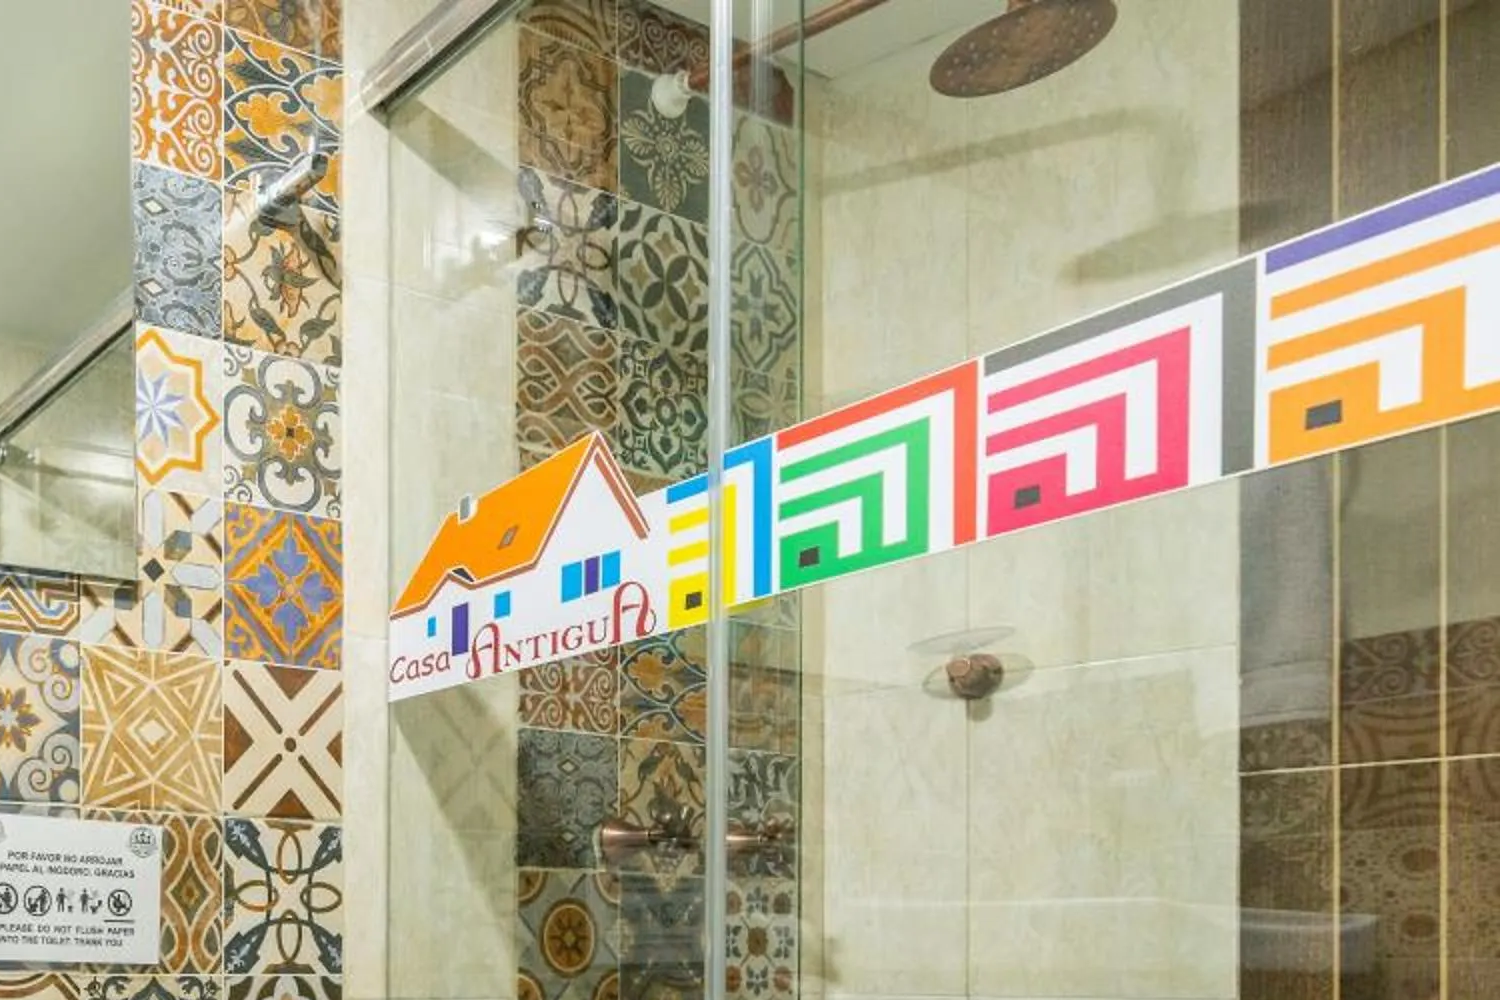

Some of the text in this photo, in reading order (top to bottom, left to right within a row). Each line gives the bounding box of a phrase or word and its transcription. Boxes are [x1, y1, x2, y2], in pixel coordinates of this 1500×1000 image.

[389, 650, 452, 684] Casa
[7, 850, 123, 866] POR FAVOR NO ARROJAR
[0, 862, 30, 872] PAPEL
[32, 865, 44, 875] AL
[94, 868, 136, 879] GRACIAS
[37, 924, 51, 934] DO
[53, 925, 72, 934] NOT
[75, 926, 104, 936] FLUSH
[107, 927, 135, 937] PAPER
[22, 936, 39, 945] THE
[74, 937, 102, 947] THANK
[105, 938, 123, 947] YOU
